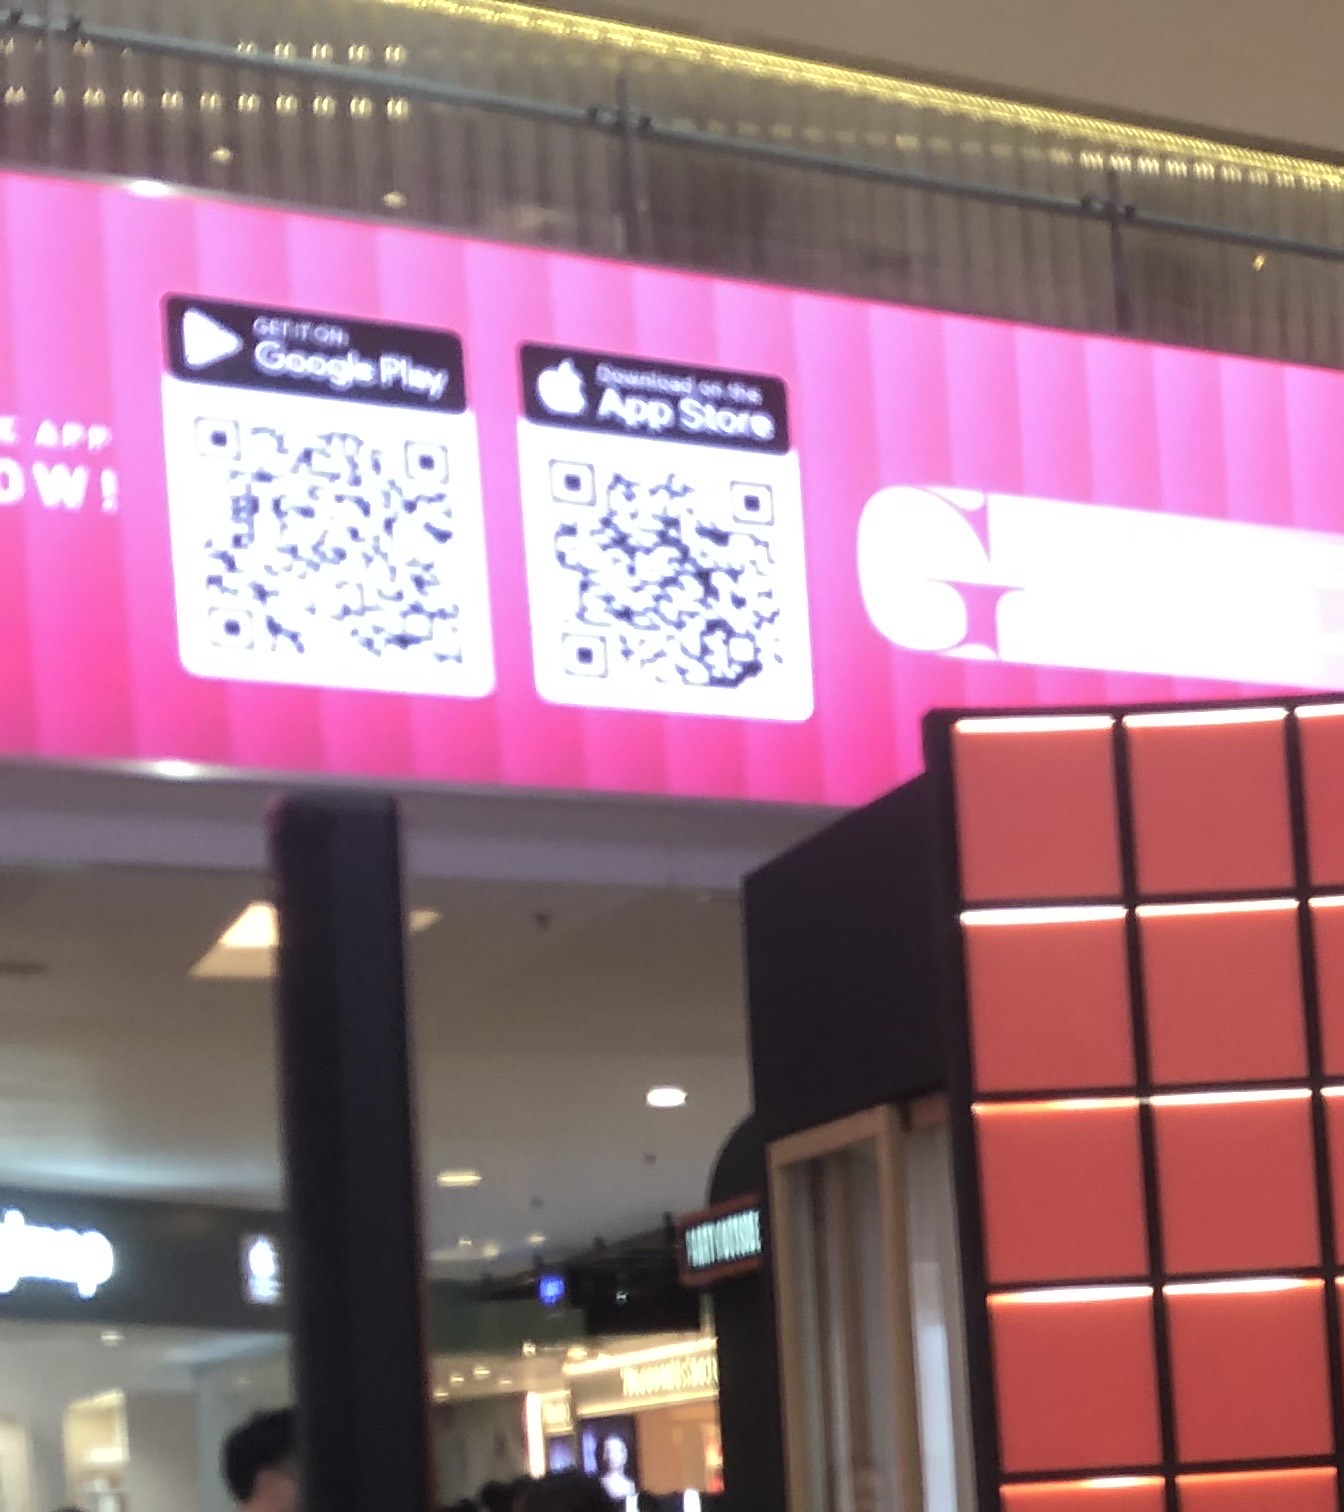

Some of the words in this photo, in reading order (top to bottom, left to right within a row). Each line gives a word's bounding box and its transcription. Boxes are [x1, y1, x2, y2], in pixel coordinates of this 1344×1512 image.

[253, 316, 288, 338] GET
[254, 340, 375, 391] Google
[379, 353, 448, 400] Play
[596, 363, 693, 396] Download
[727, 382, 763, 405] the
[33, 418, 113, 450] APP
[597, 387, 675, 432] App
[678, 397, 776, 440] Store
